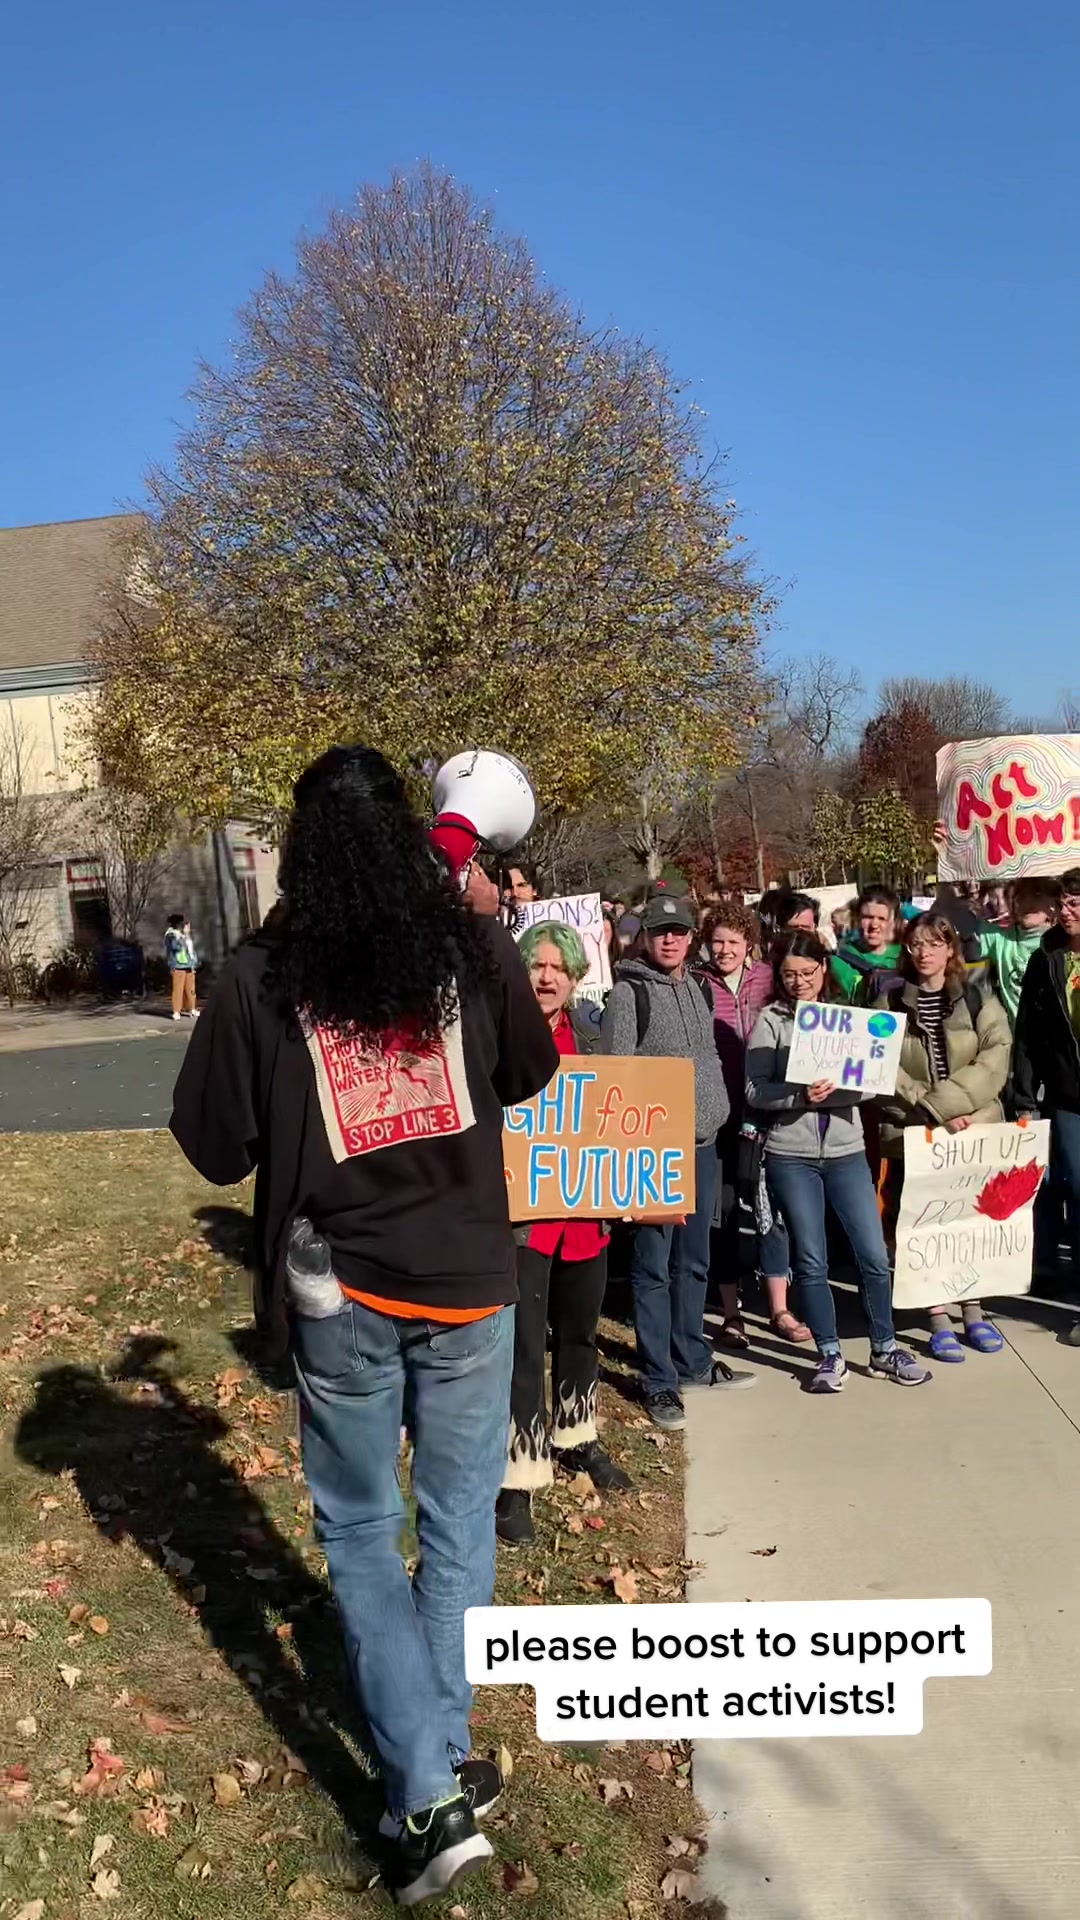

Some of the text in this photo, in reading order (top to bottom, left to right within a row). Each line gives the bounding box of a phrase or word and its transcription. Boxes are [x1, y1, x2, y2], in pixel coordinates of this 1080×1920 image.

[798, 1004, 853, 1034] OUR
[795, 1032, 885, 1059] FUTURE is
[331, 1055, 359, 1077] THE
[335, 1066, 384, 1093] WATER
[502, 1072, 667, 1139] GHT for
[350, 1109, 456, 1149] STOP LINE 3
[932, 1132, 1036, 1170] SHUT UP
[528, 1144, 684, 1210] FUTURE
[912, 1200, 965, 1229] DO
